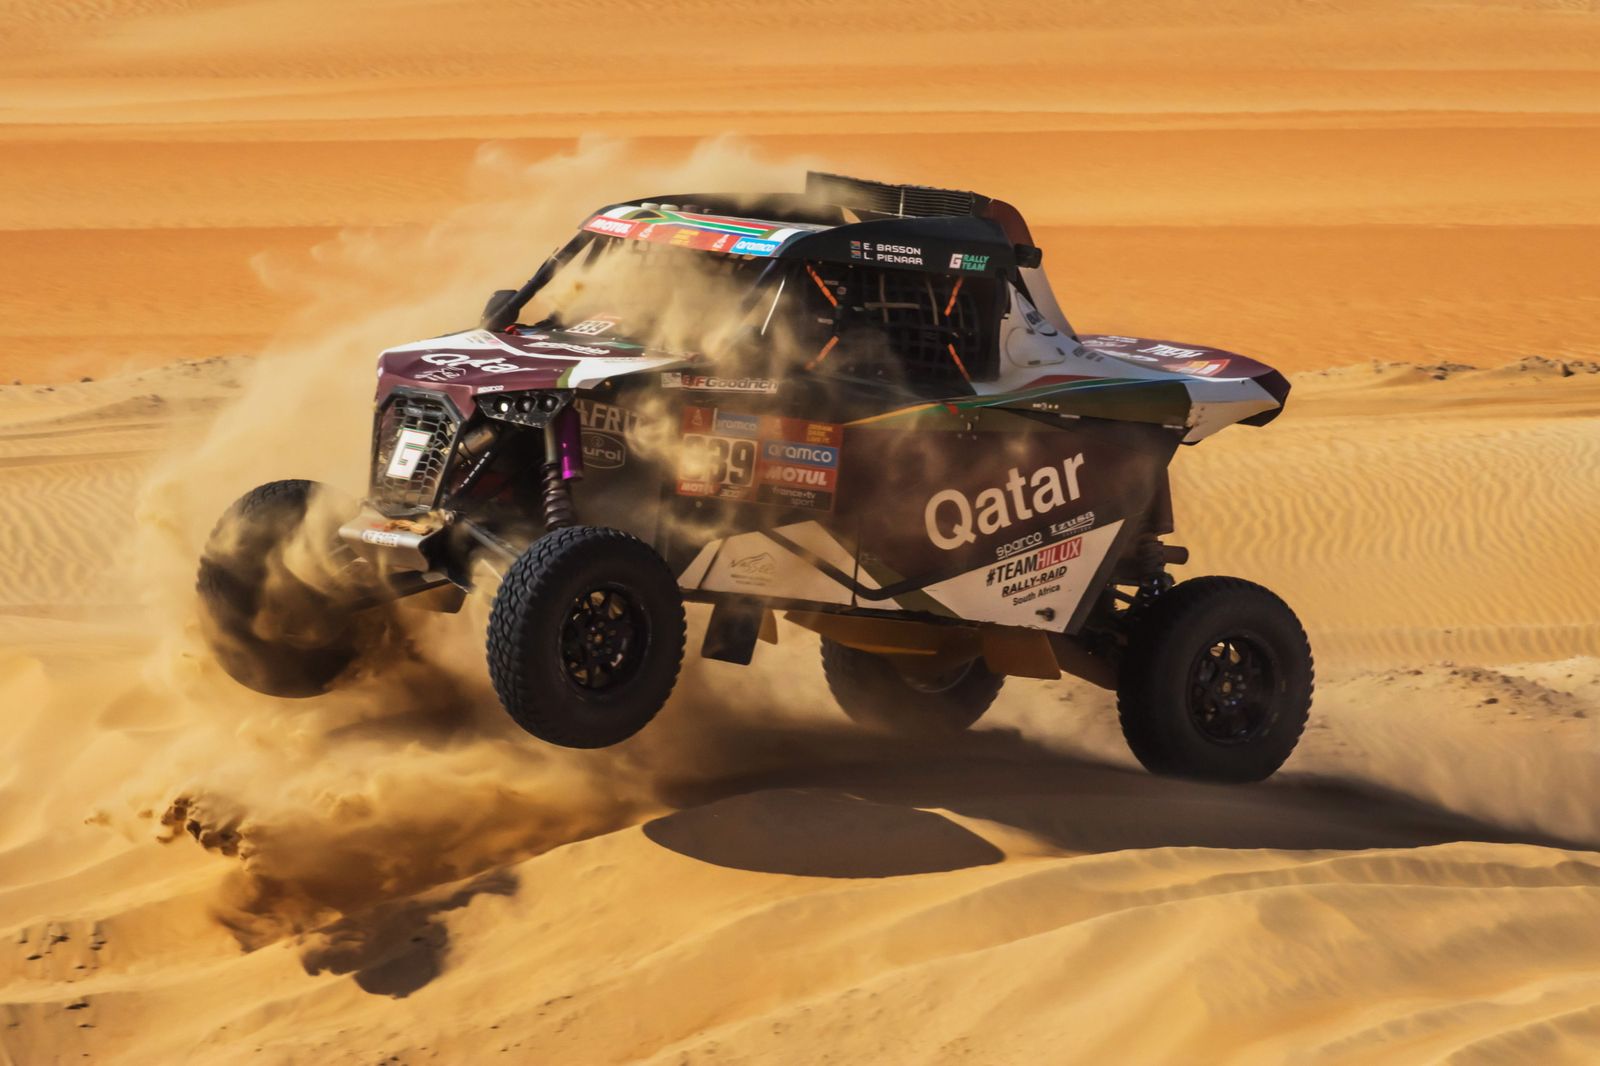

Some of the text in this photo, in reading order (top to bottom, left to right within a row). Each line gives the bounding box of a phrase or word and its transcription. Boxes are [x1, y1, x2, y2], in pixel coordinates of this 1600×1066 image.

[863, 242, 922, 255] E. BASSON
[863, 252, 924, 265] L. PIENAAR
[961, 262, 986, 272] TEAM
[962, 254, 990, 264] RALLY
[681, 375, 779, 391] BFGoodrich
[684, 436, 756, 486] 39
[768, 445, 833, 463] aramco
[765, 466, 828, 486] MOTUL
[925, 453, 1085, 550] Qatar
[996, 531, 1043, 559] sparco
[986, 537, 1082, 587] #TEAMHILUX
[1002, 565, 1068, 597] RALLY-RAID
[1013, 584, 1061, 606] South Africa
